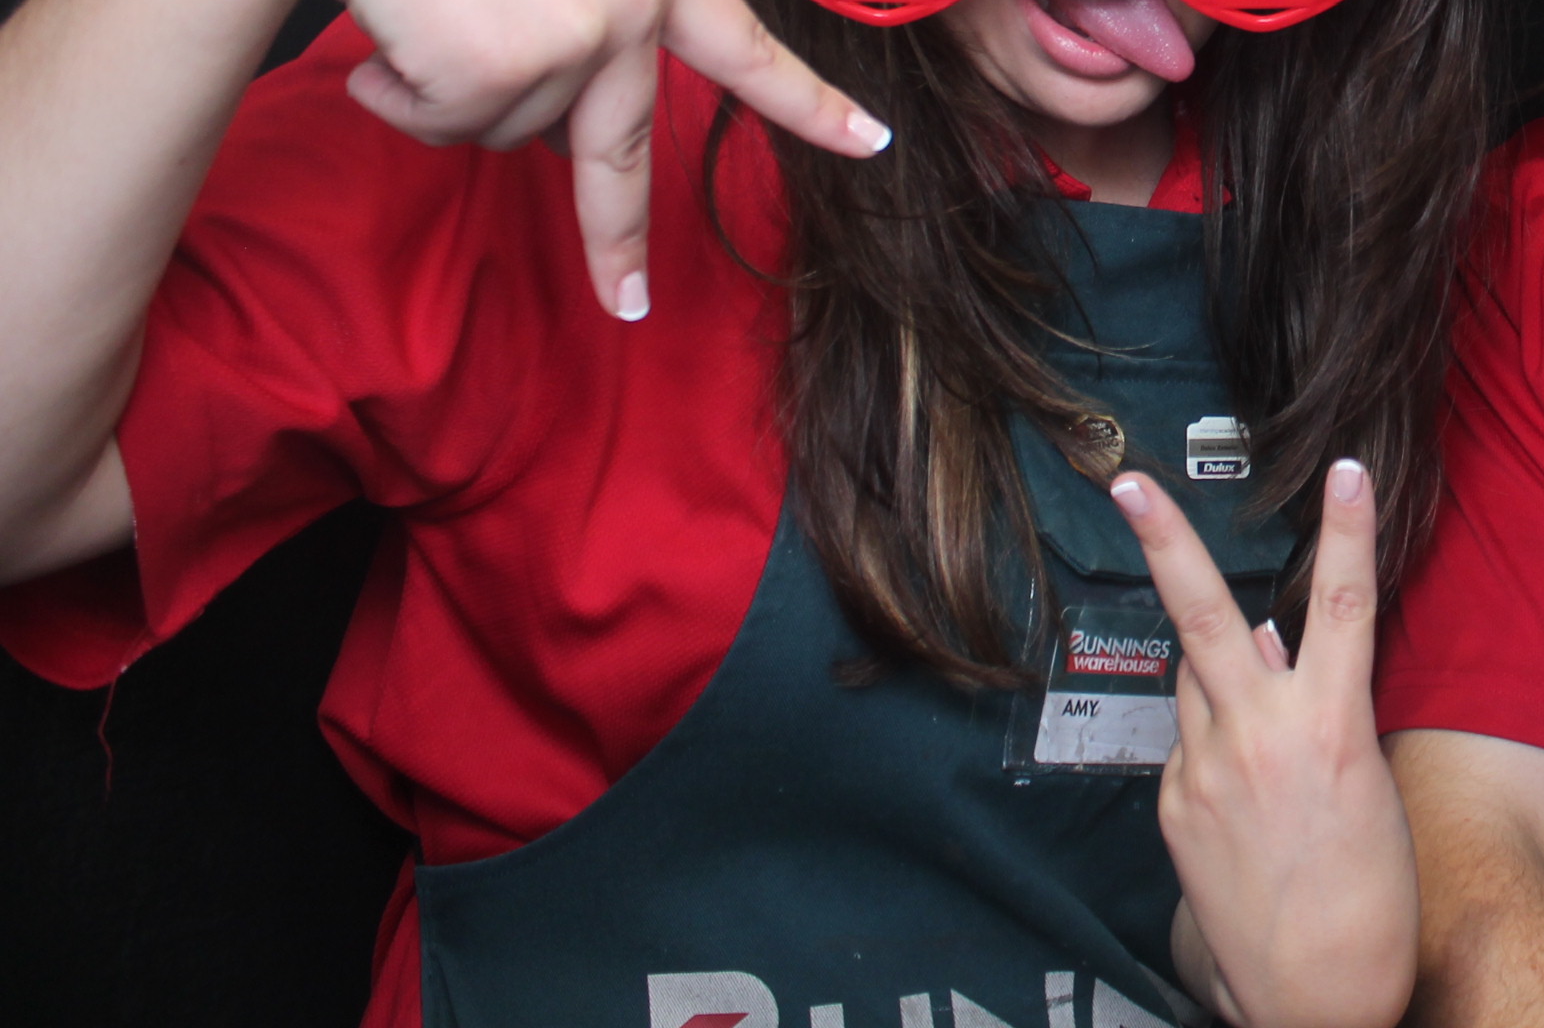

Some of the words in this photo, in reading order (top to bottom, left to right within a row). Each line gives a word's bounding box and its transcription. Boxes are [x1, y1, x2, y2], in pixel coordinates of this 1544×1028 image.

[1203, 462, 1236, 473] Dulux
[1069, 629, 1171, 659] BUNNINGS
[1073, 653, 1160, 674] warehouse
[1061, 698, 1100, 718] AMY
